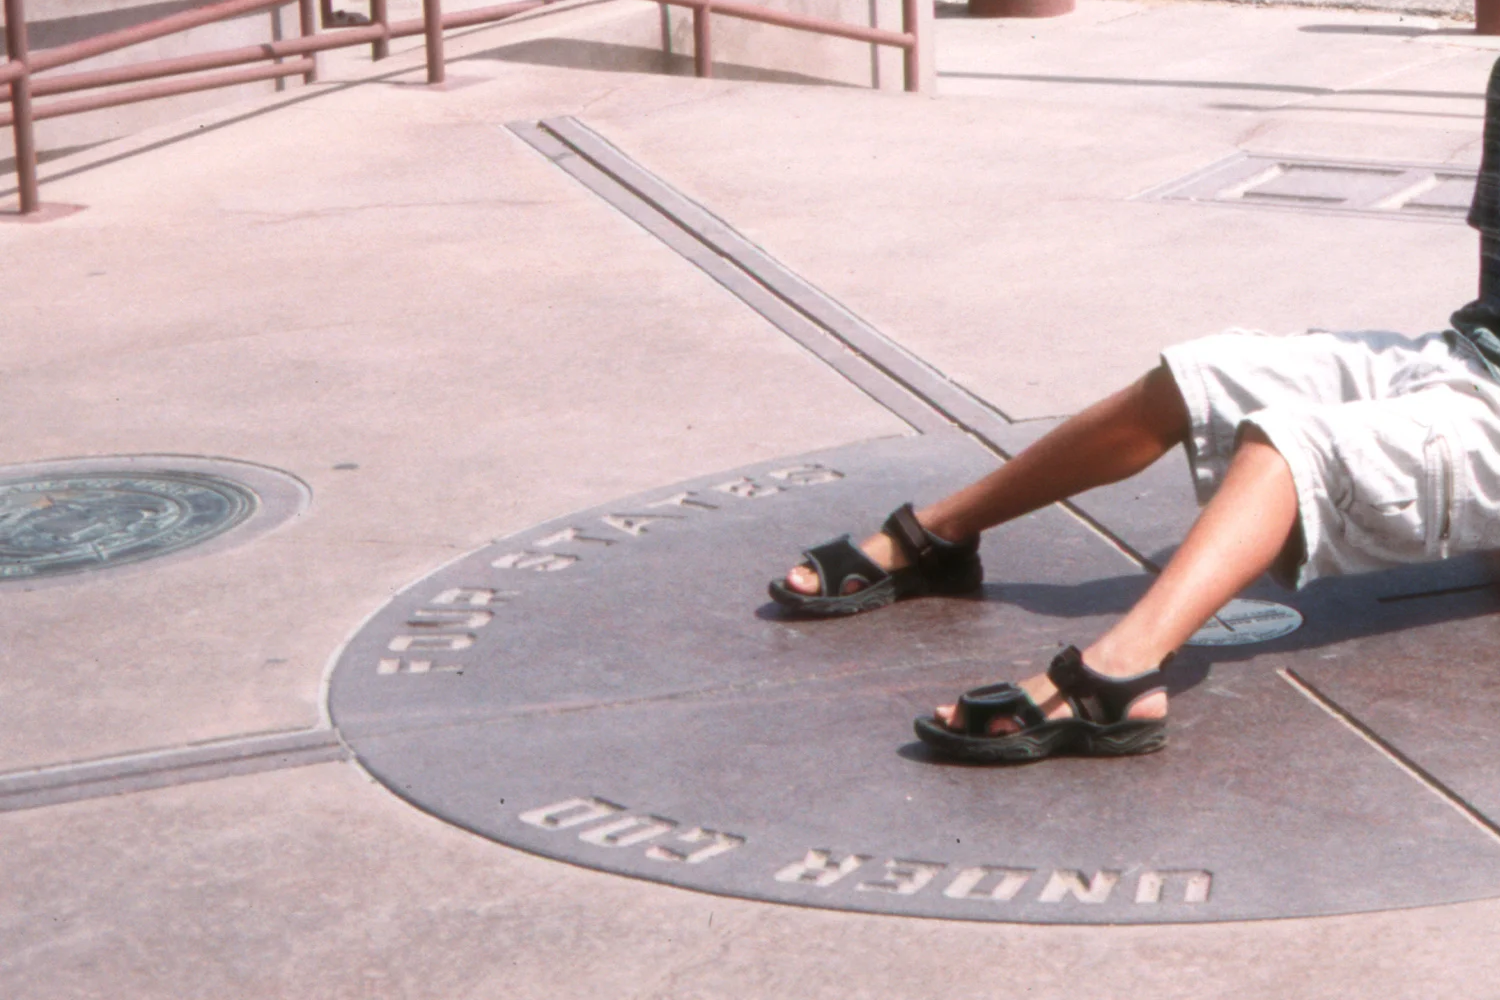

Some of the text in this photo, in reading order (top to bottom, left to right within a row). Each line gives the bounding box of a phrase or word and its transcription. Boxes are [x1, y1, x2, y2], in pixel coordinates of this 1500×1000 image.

[377, 460, 846, 676] FOUR STATES
[517, 796, 1215, 905] UNDER GOD
